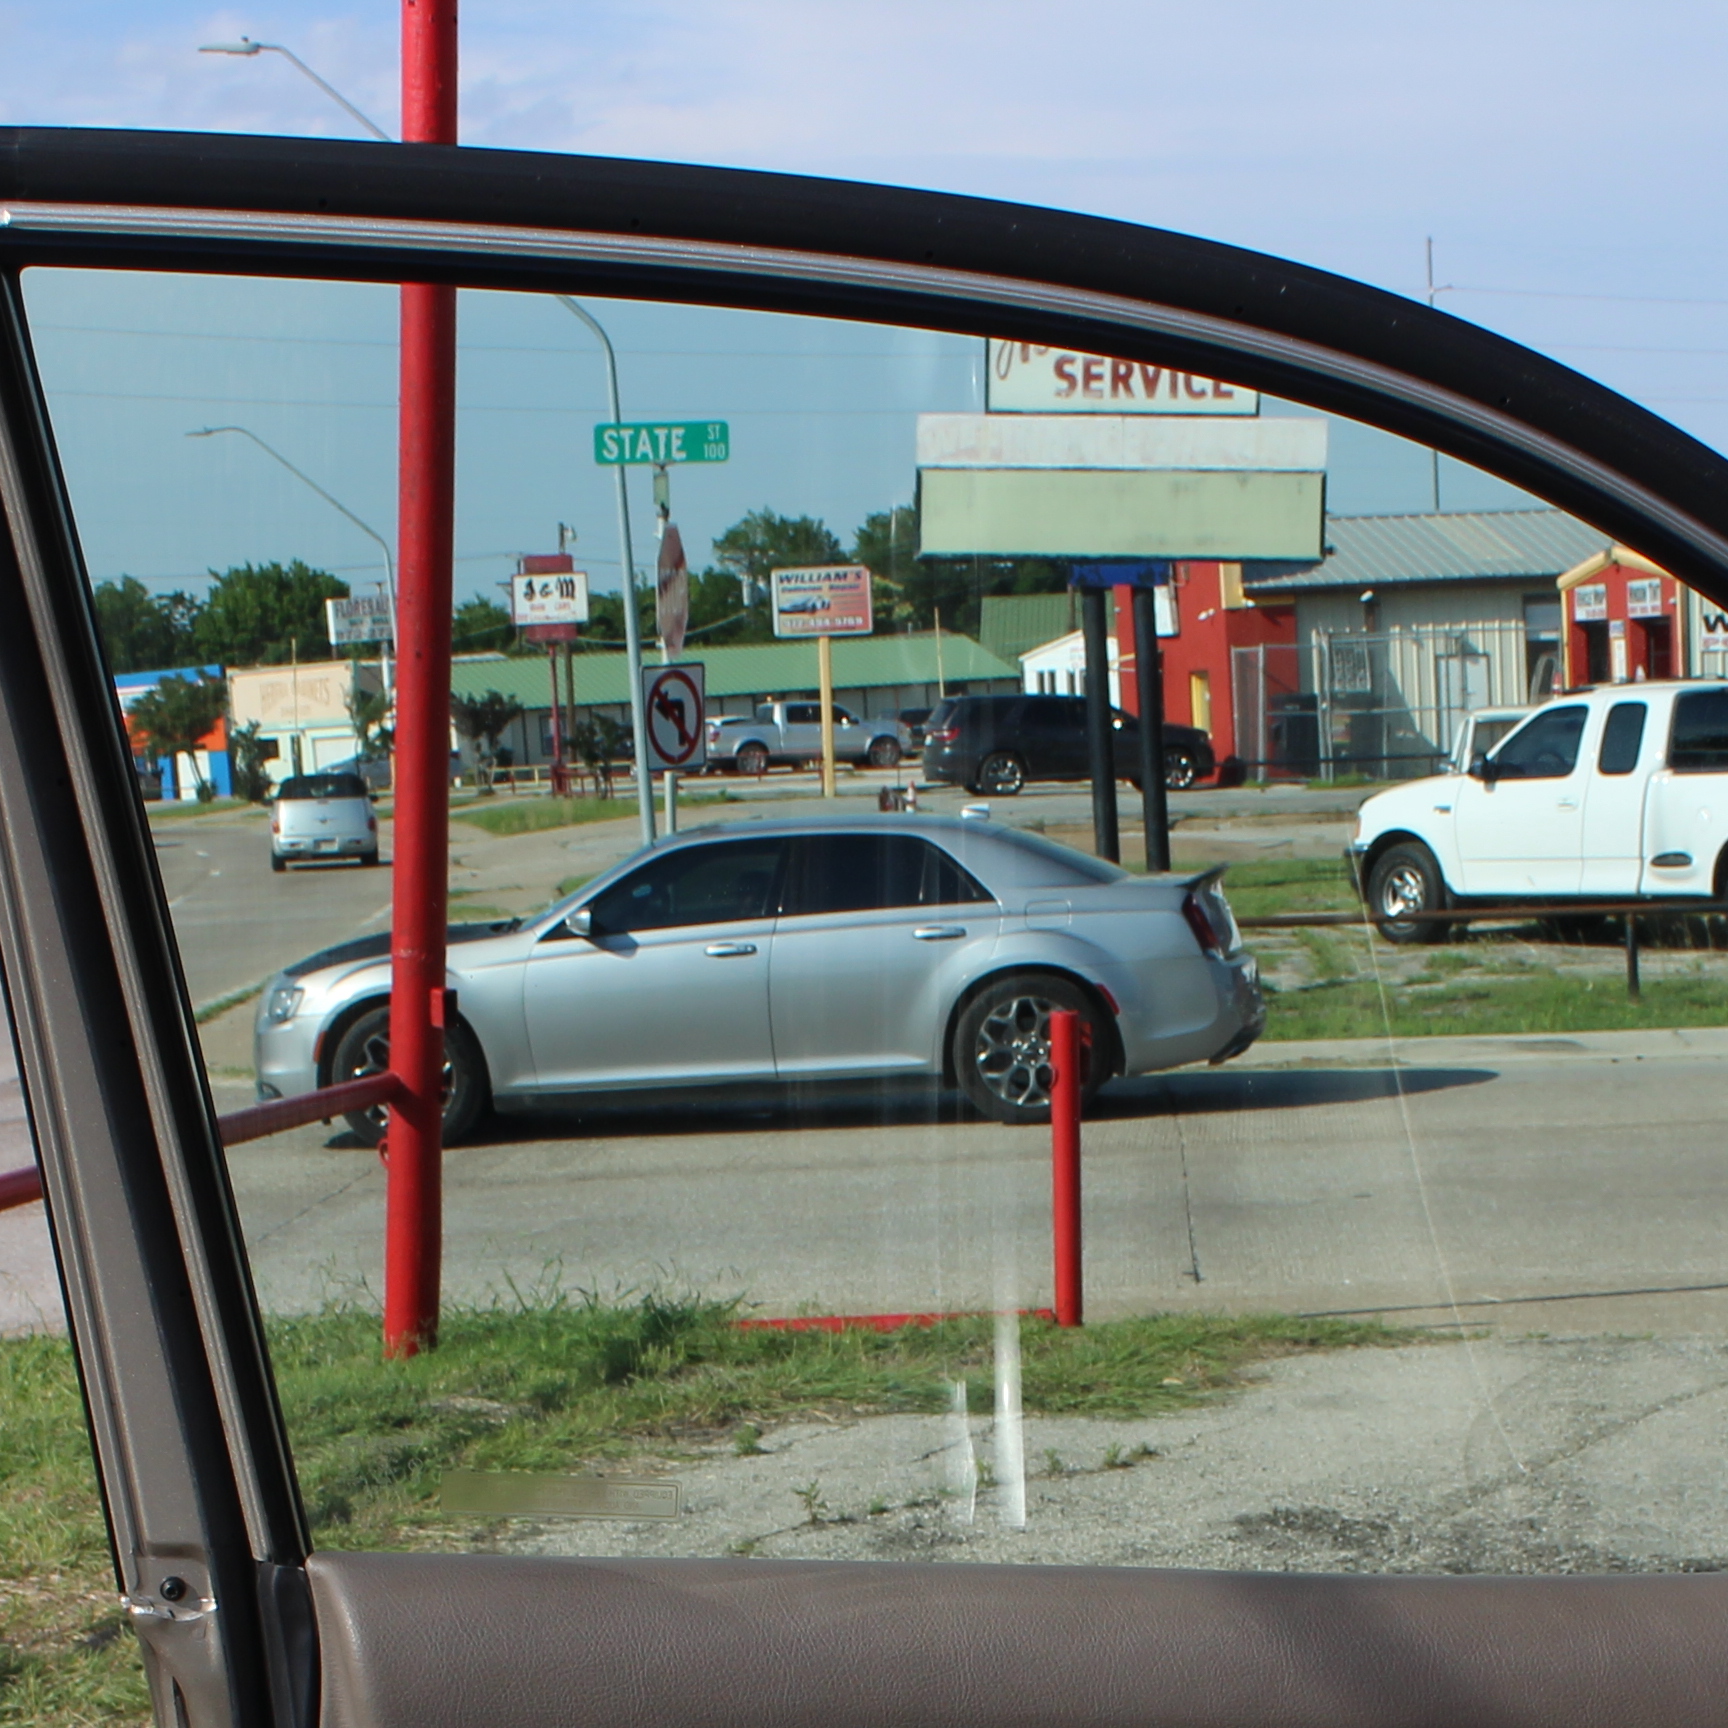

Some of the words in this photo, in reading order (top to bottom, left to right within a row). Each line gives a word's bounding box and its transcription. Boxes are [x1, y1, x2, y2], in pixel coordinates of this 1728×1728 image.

[707, 424, 721, 440] ST
[602, 427, 687, 460] STATE
[703, 443, 725, 459] 100
